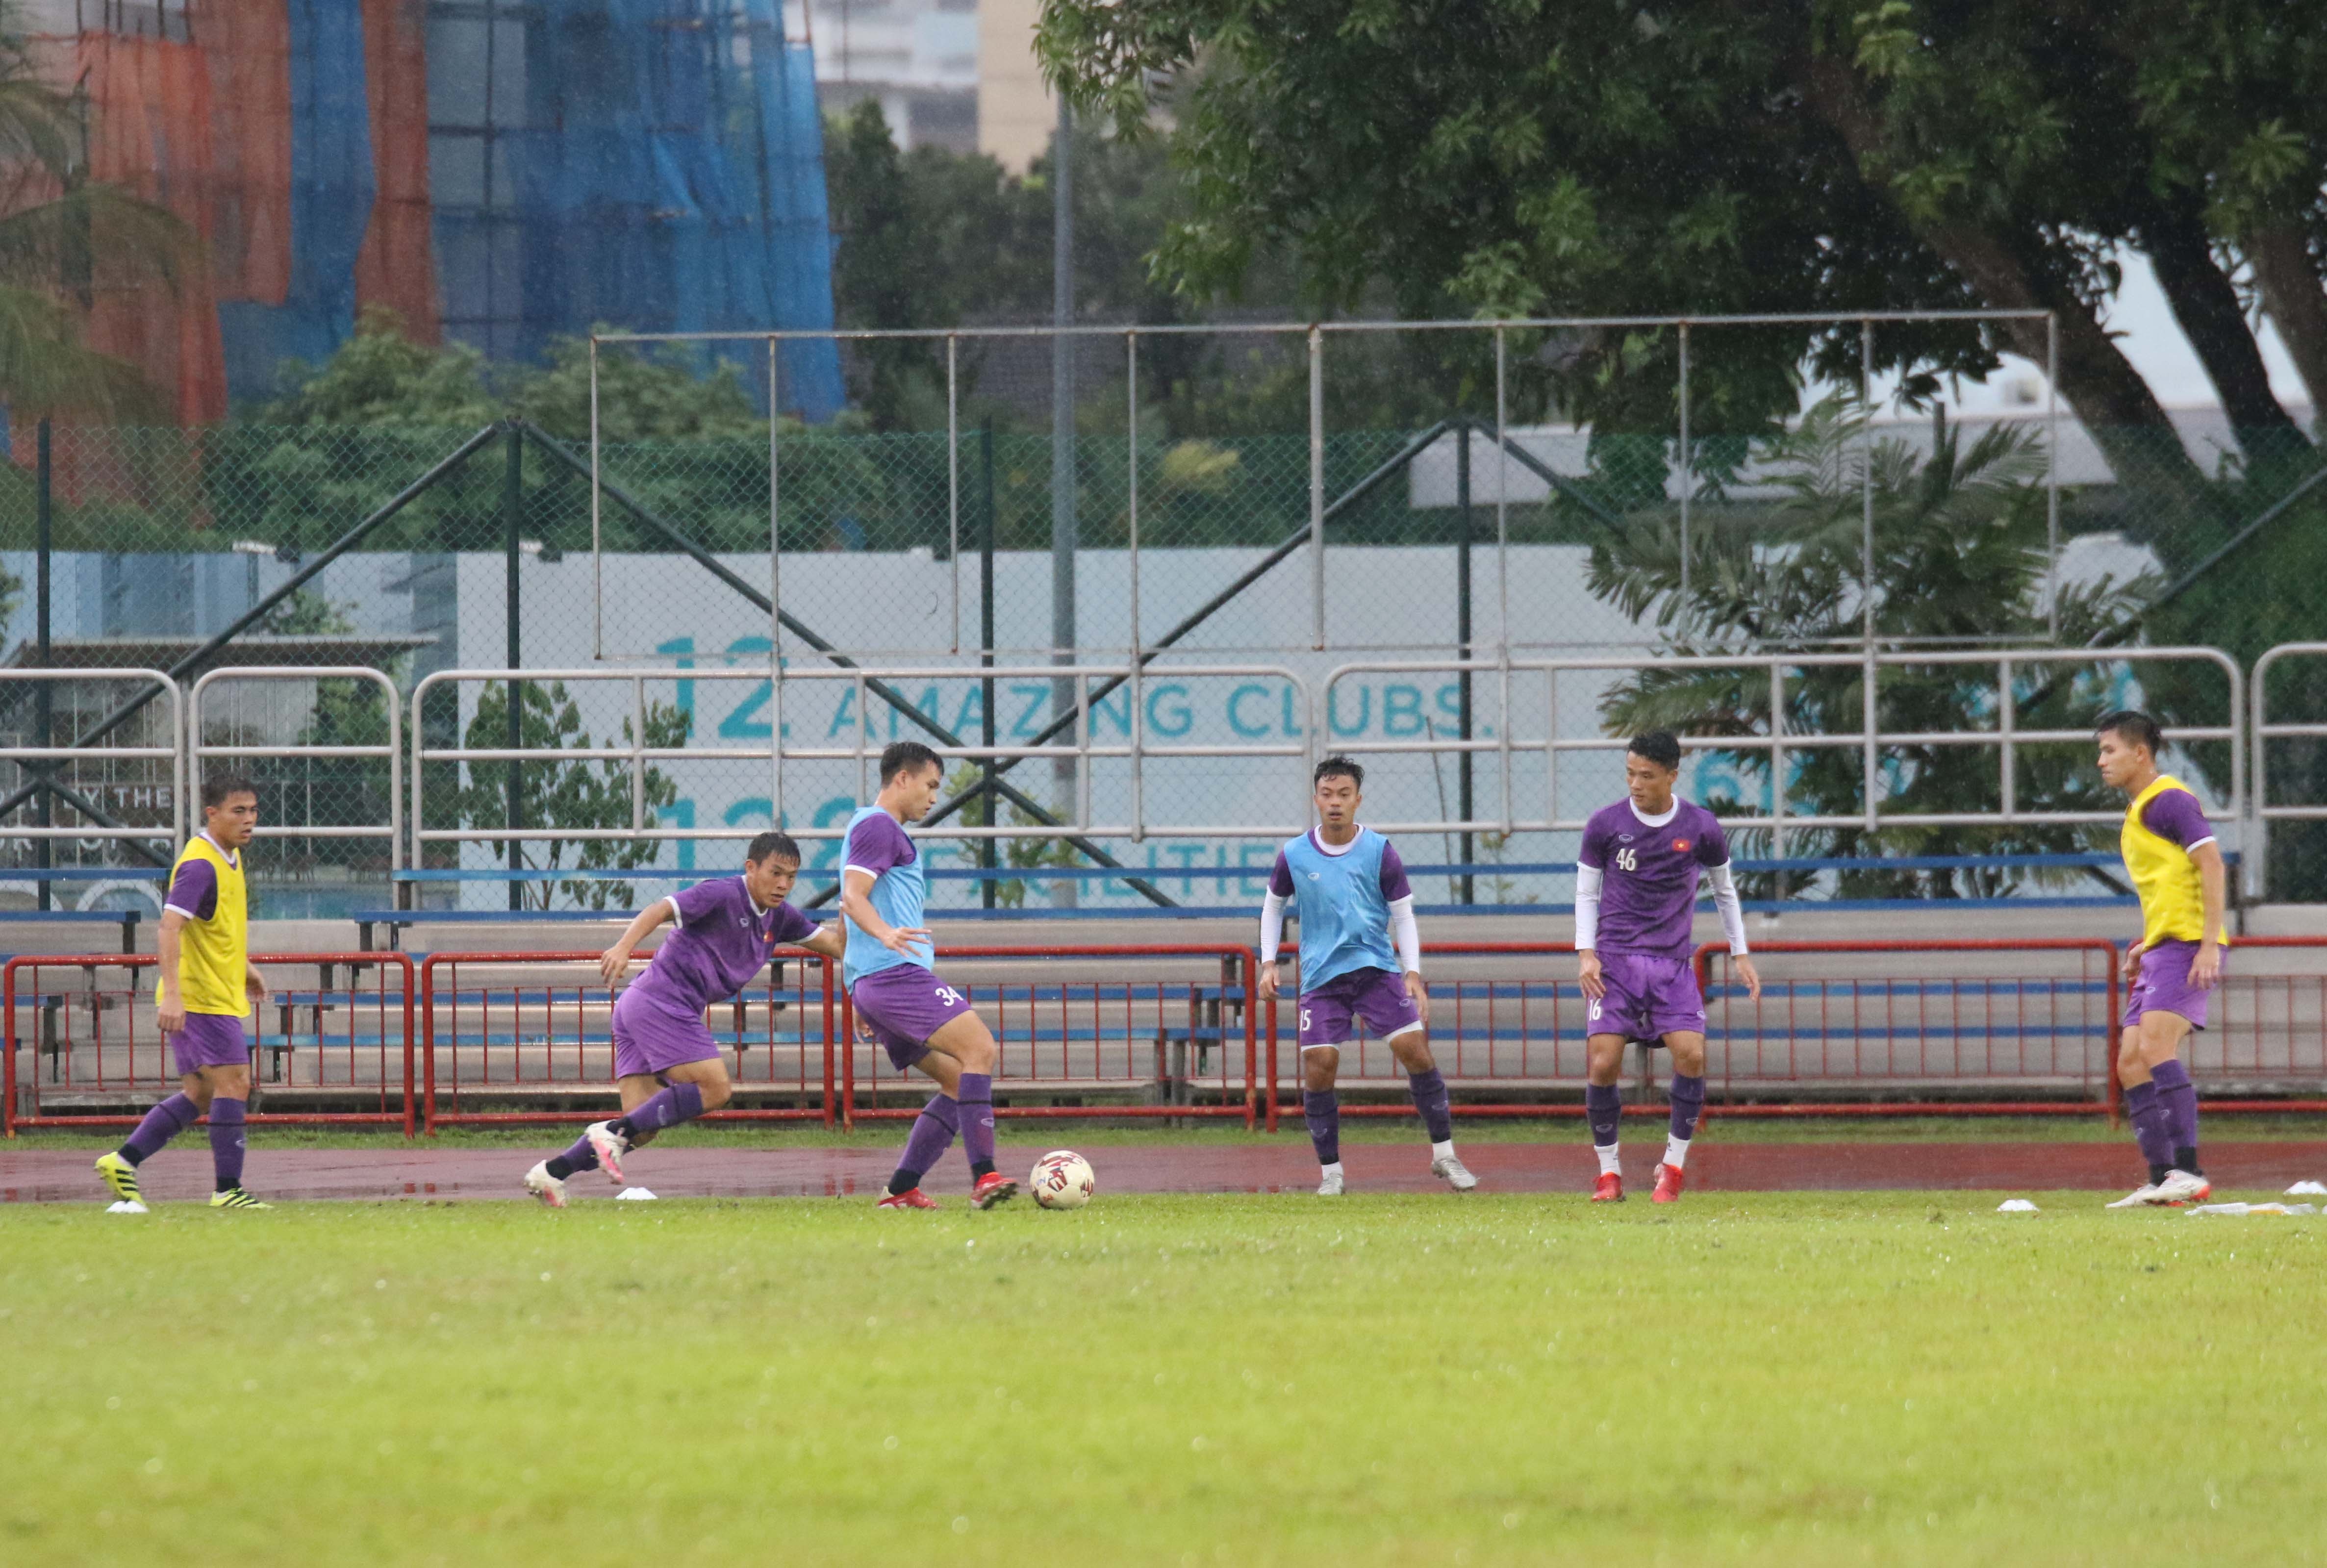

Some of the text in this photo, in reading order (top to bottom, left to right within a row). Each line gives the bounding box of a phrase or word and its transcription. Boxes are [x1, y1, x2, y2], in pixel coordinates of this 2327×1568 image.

[657, 636, 1493, 737] 12 AMAZNG CLUBS.
[114, 786, 172, 808] THE
[1616, 848, 1637, 871] 46
[935, 986, 963, 1006] 34
